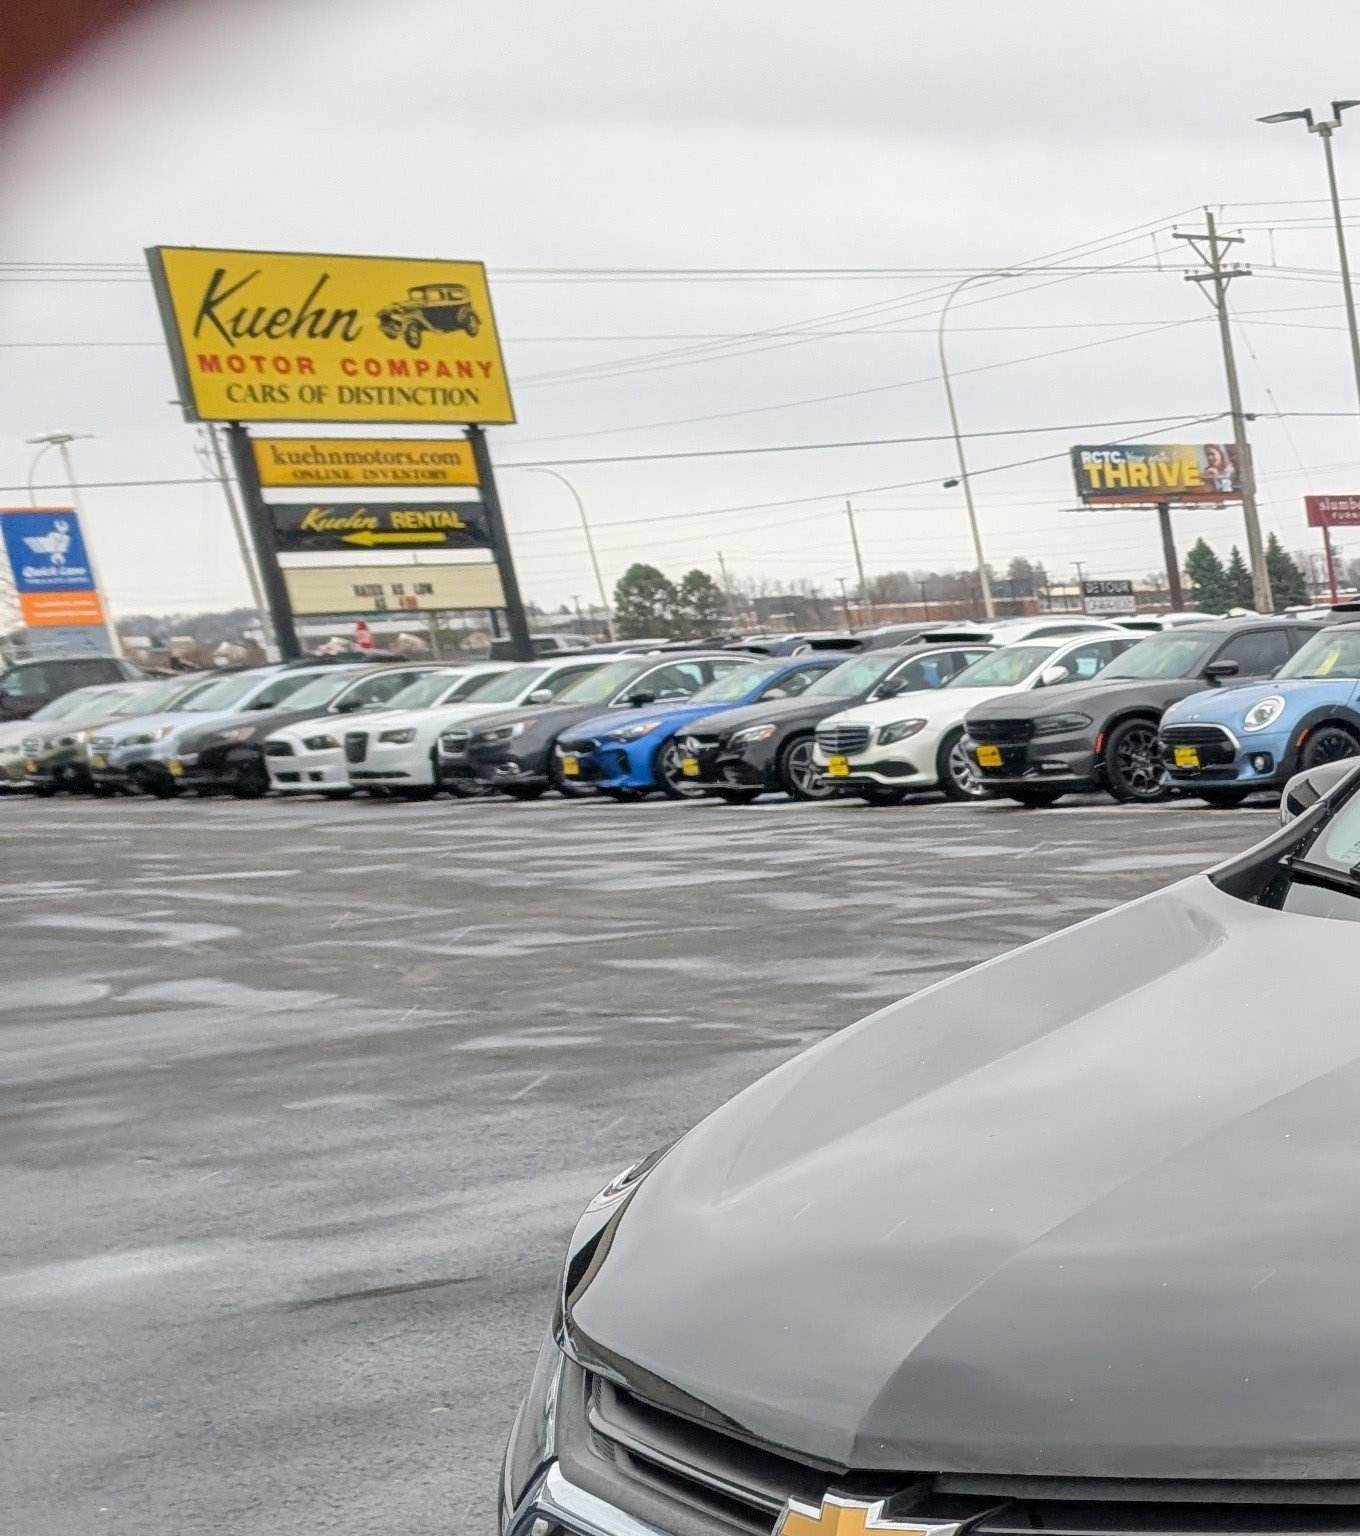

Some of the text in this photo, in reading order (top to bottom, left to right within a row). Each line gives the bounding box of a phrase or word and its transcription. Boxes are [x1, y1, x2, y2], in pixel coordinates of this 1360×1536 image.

[192, 267, 365, 348] Kuehn
[196, 353, 493, 379] MOTOR COMPANY
[226, 383, 481, 406] CARS OF DISTINCTION
[270, 444, 463, 467] kuehnmotors.com
[292, 468, 355, 481] ONLINE
[300, 507, 467, 531] Kuehn RENTAL
